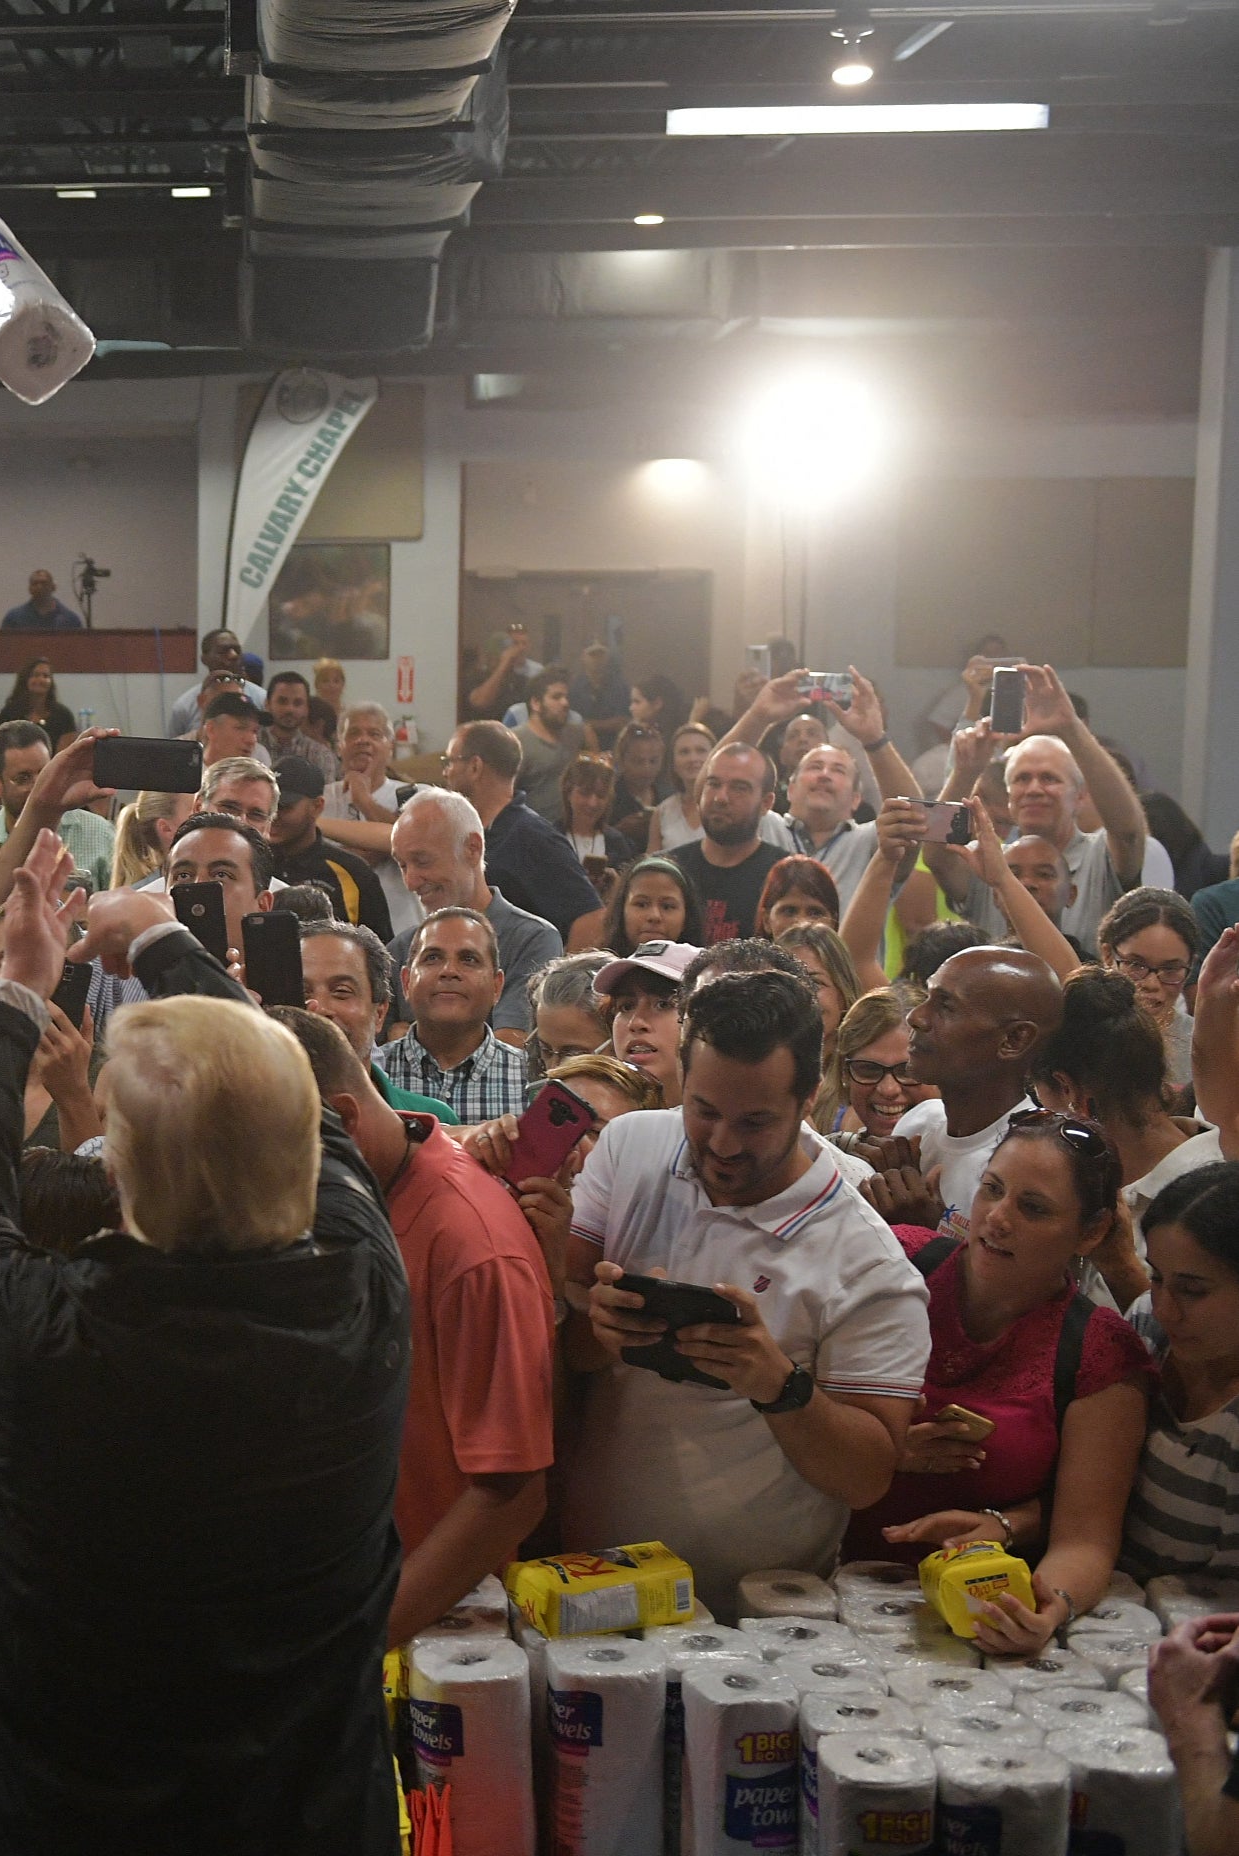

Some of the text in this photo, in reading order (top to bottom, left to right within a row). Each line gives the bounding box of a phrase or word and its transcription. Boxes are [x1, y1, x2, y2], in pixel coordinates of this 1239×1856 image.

[239, 475, 310, 590] CALVARY
[296, 389, 367, 480] CHAPEL
[738, 1735, 754, 1762] 1
[734, 1786, 792, 1808] pape
[864, 1812, 877, 1841] 1
